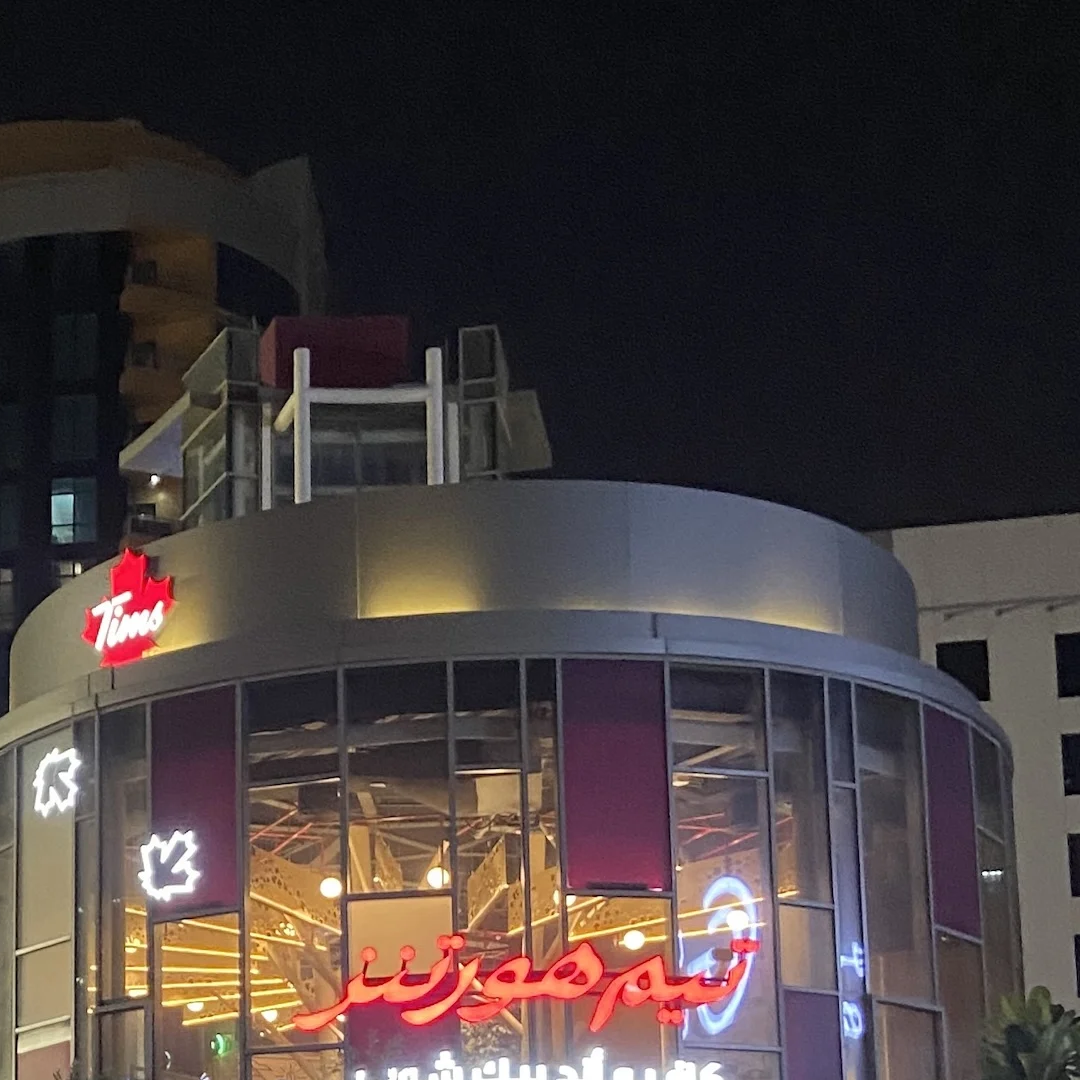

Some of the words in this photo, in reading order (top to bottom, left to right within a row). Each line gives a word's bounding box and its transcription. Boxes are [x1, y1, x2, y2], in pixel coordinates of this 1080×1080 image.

[91, 591, 164, 651] Tims
[291, 934, 605, 1032] هورتنز
[588, 937, 761, 1033] تيم
